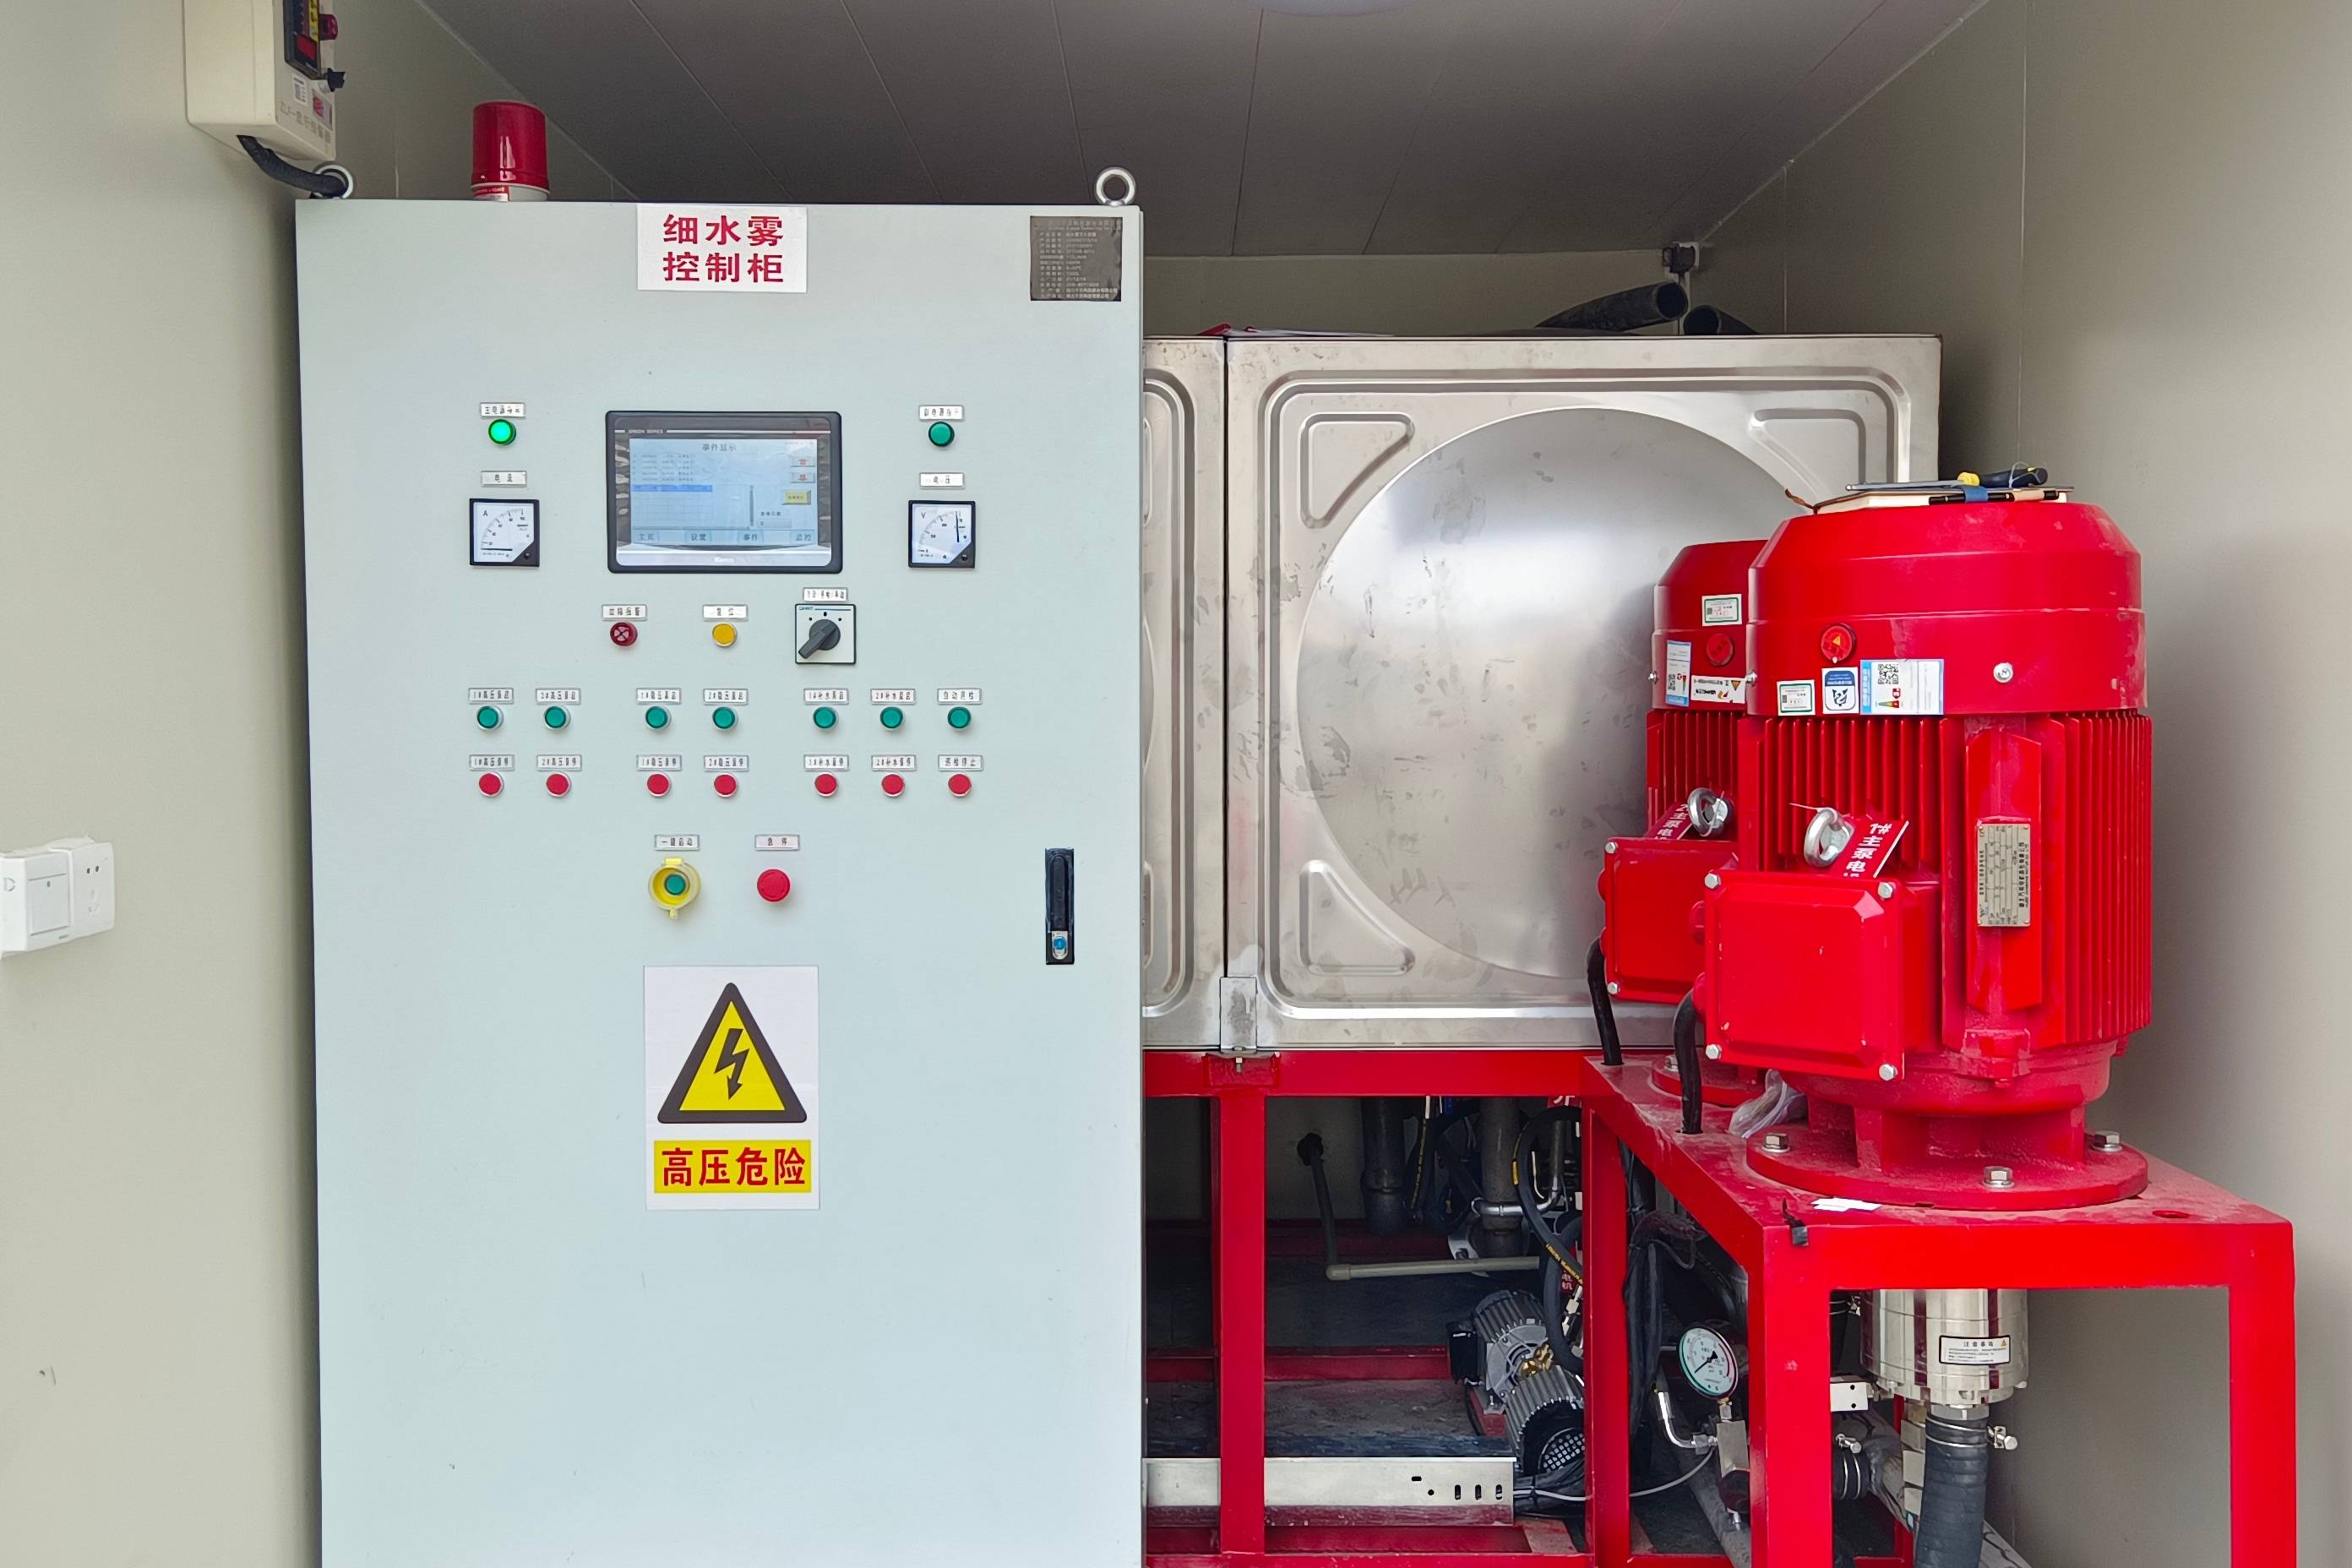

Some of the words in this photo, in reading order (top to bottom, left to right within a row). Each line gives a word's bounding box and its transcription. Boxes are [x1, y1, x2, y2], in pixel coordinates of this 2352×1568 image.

[663, 214, 783, 247] 细水雾
[662, 252, 783, 282] 控制柜
[662, 1147, 805, 1186] 高压危险
